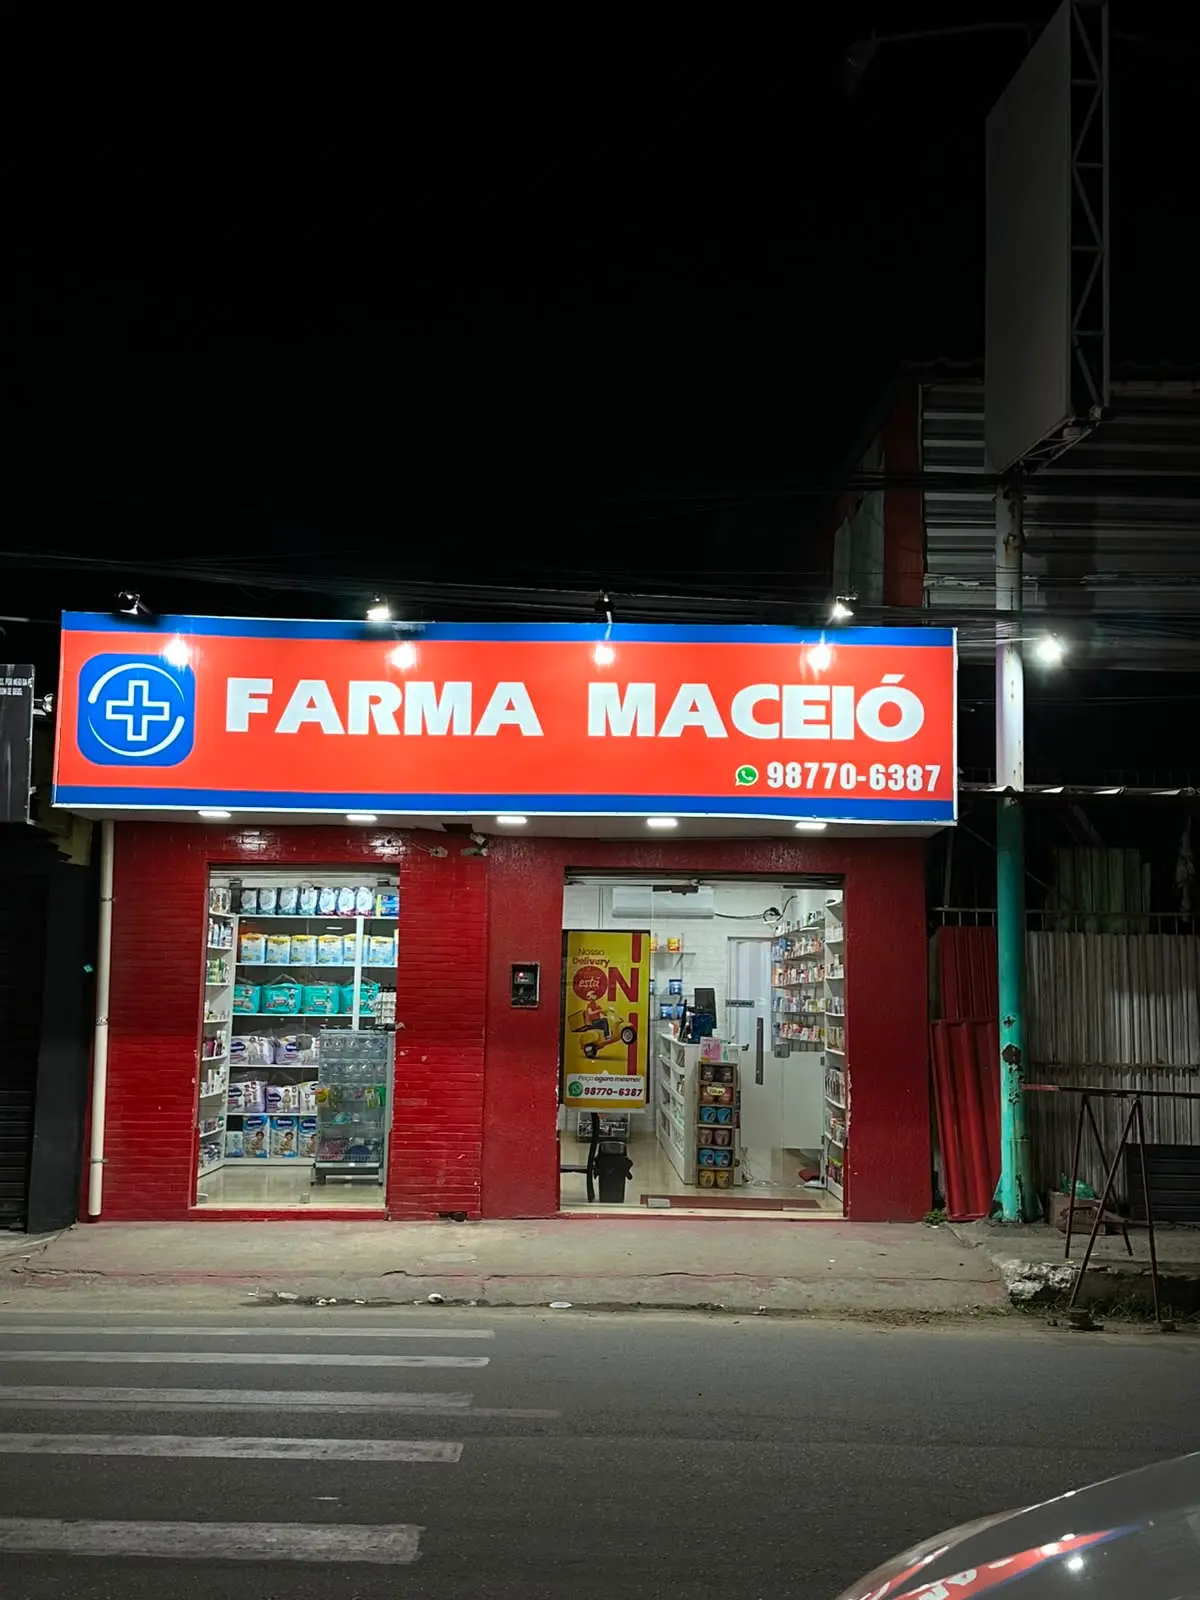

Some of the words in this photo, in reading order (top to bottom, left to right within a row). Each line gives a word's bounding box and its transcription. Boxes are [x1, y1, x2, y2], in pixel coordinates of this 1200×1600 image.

[226, 677, 544, 737] FARMA
[587, 674, 925, 742] MACEIÓ
[766, 761, 942, 792] 98770-6387
[577, 947, 605, 956] Nosso
[572, 956, 611, 968] Delivery
[578, 976, 601, 989] está
[583, 1086, 643, 1097] 98770-6387
